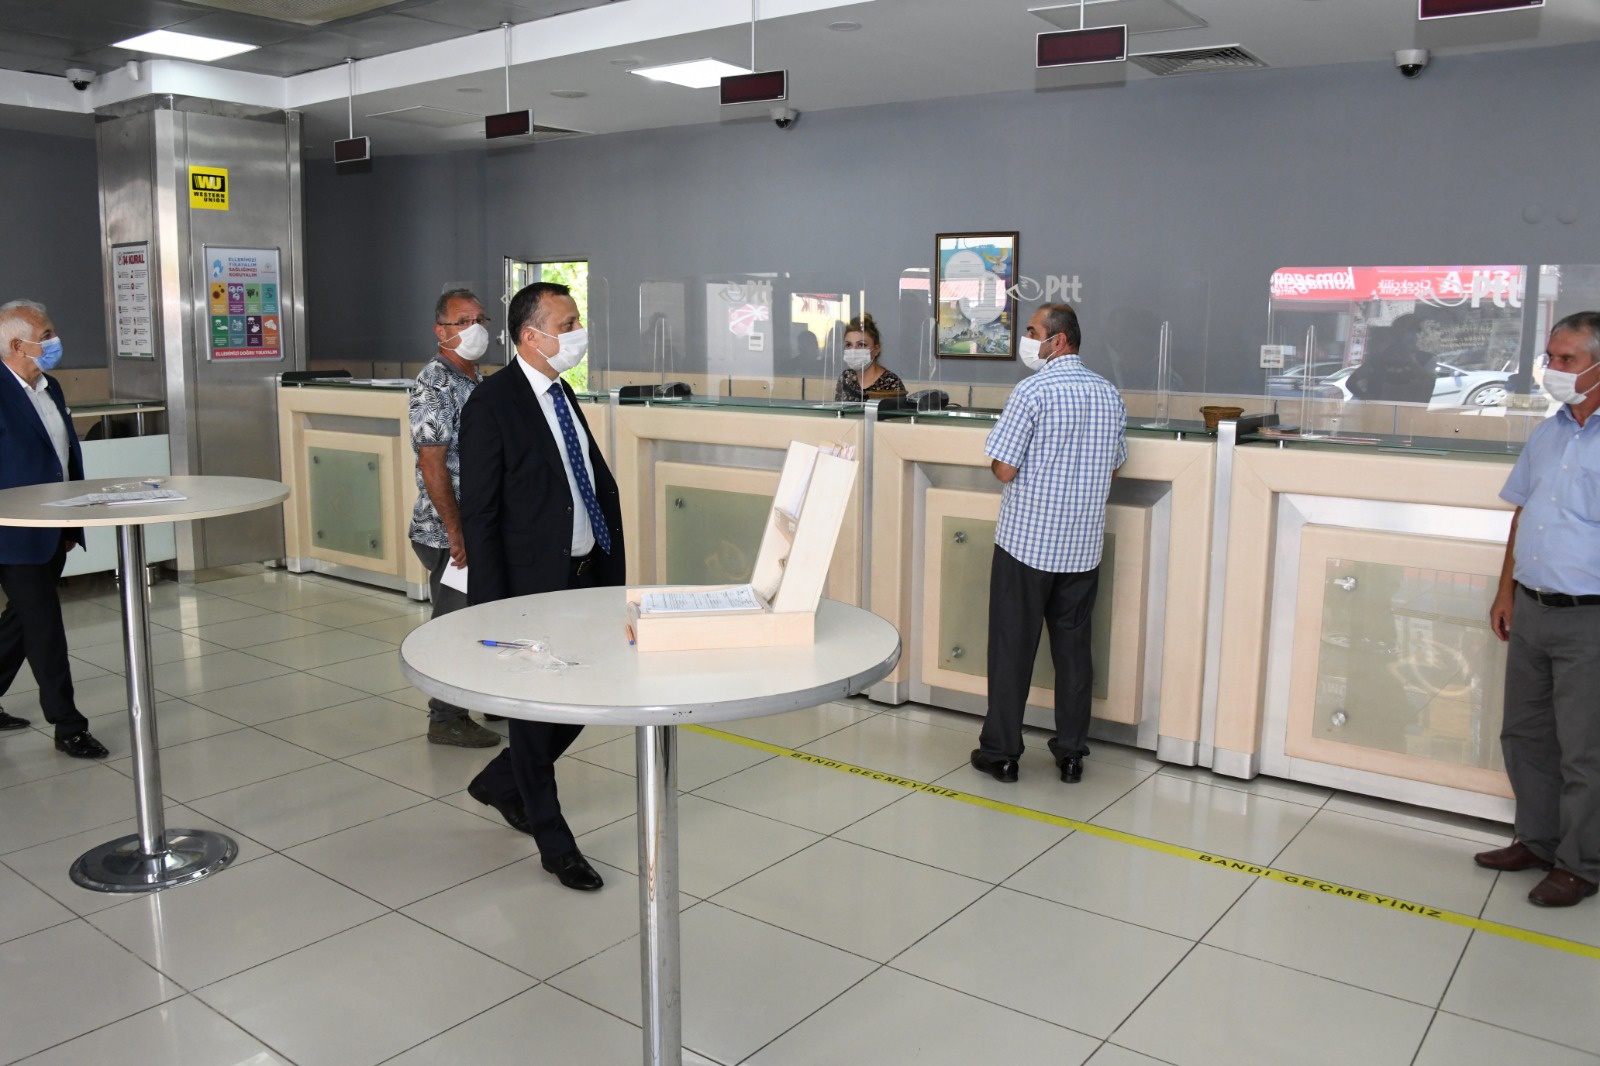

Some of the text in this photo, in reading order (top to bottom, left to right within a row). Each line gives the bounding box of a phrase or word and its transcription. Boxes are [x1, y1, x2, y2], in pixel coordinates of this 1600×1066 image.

[193, 175, 222, 190] WU
[128, 254, 146, 265] KURAL
[1045, 274, 1083, 303] Ptt
[790, 752, 842, 769] BANDI
[1199, 854, 1442, 918] BANDI GEÇMEYİNİZ
